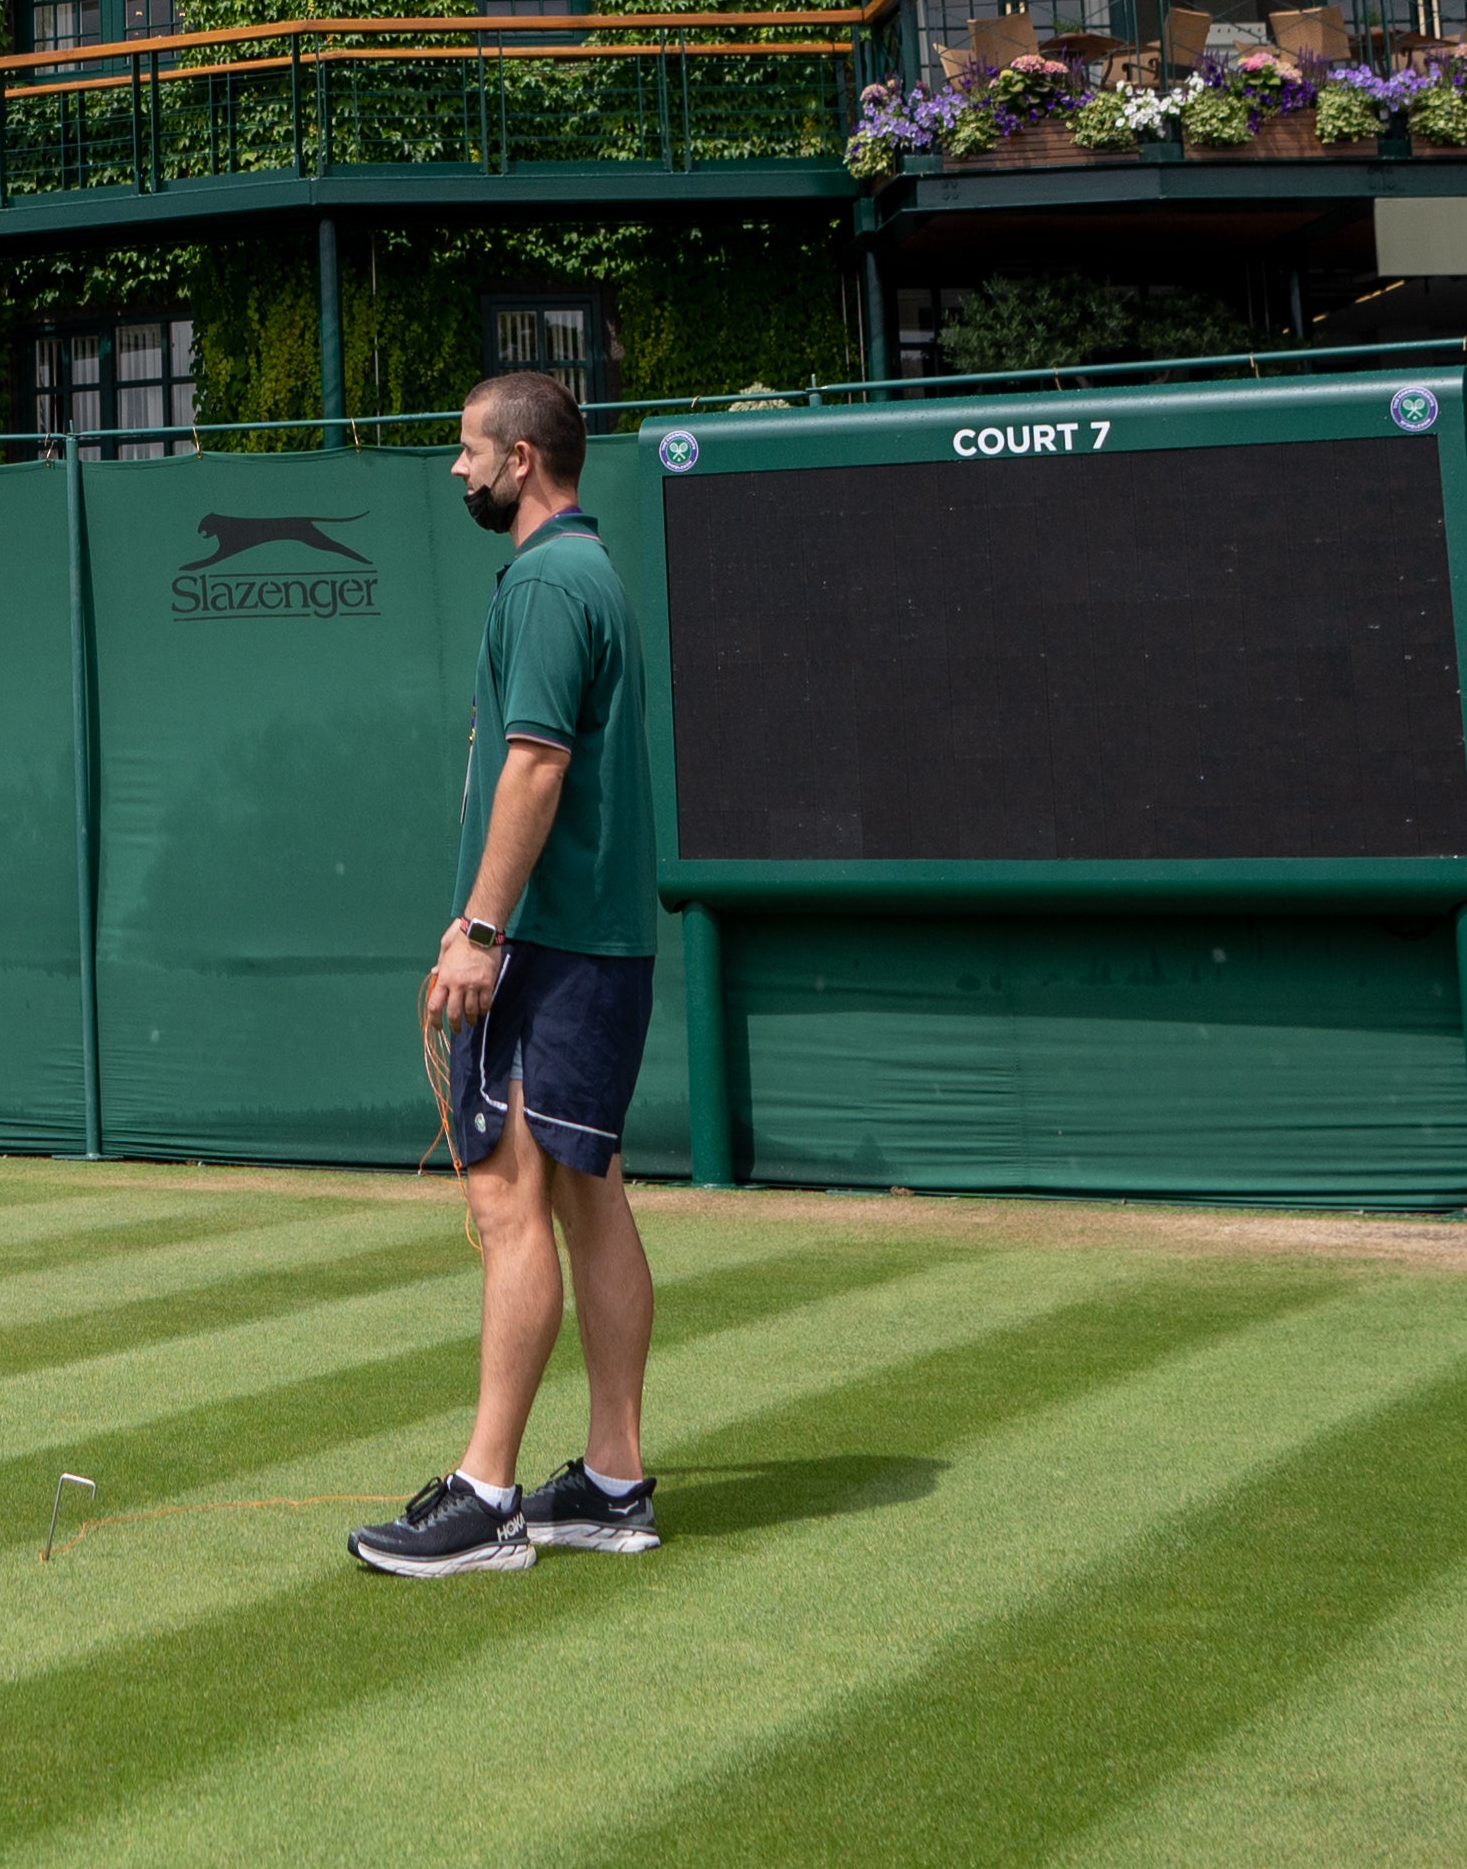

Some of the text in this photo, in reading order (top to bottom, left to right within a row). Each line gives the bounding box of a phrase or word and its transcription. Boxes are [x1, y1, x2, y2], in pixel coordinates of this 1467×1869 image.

[952, 421, 1111, 457] COURT 7
[171, 574, 380, 619] Slazenger
[496, 1511, 526, 1543] HOKA
